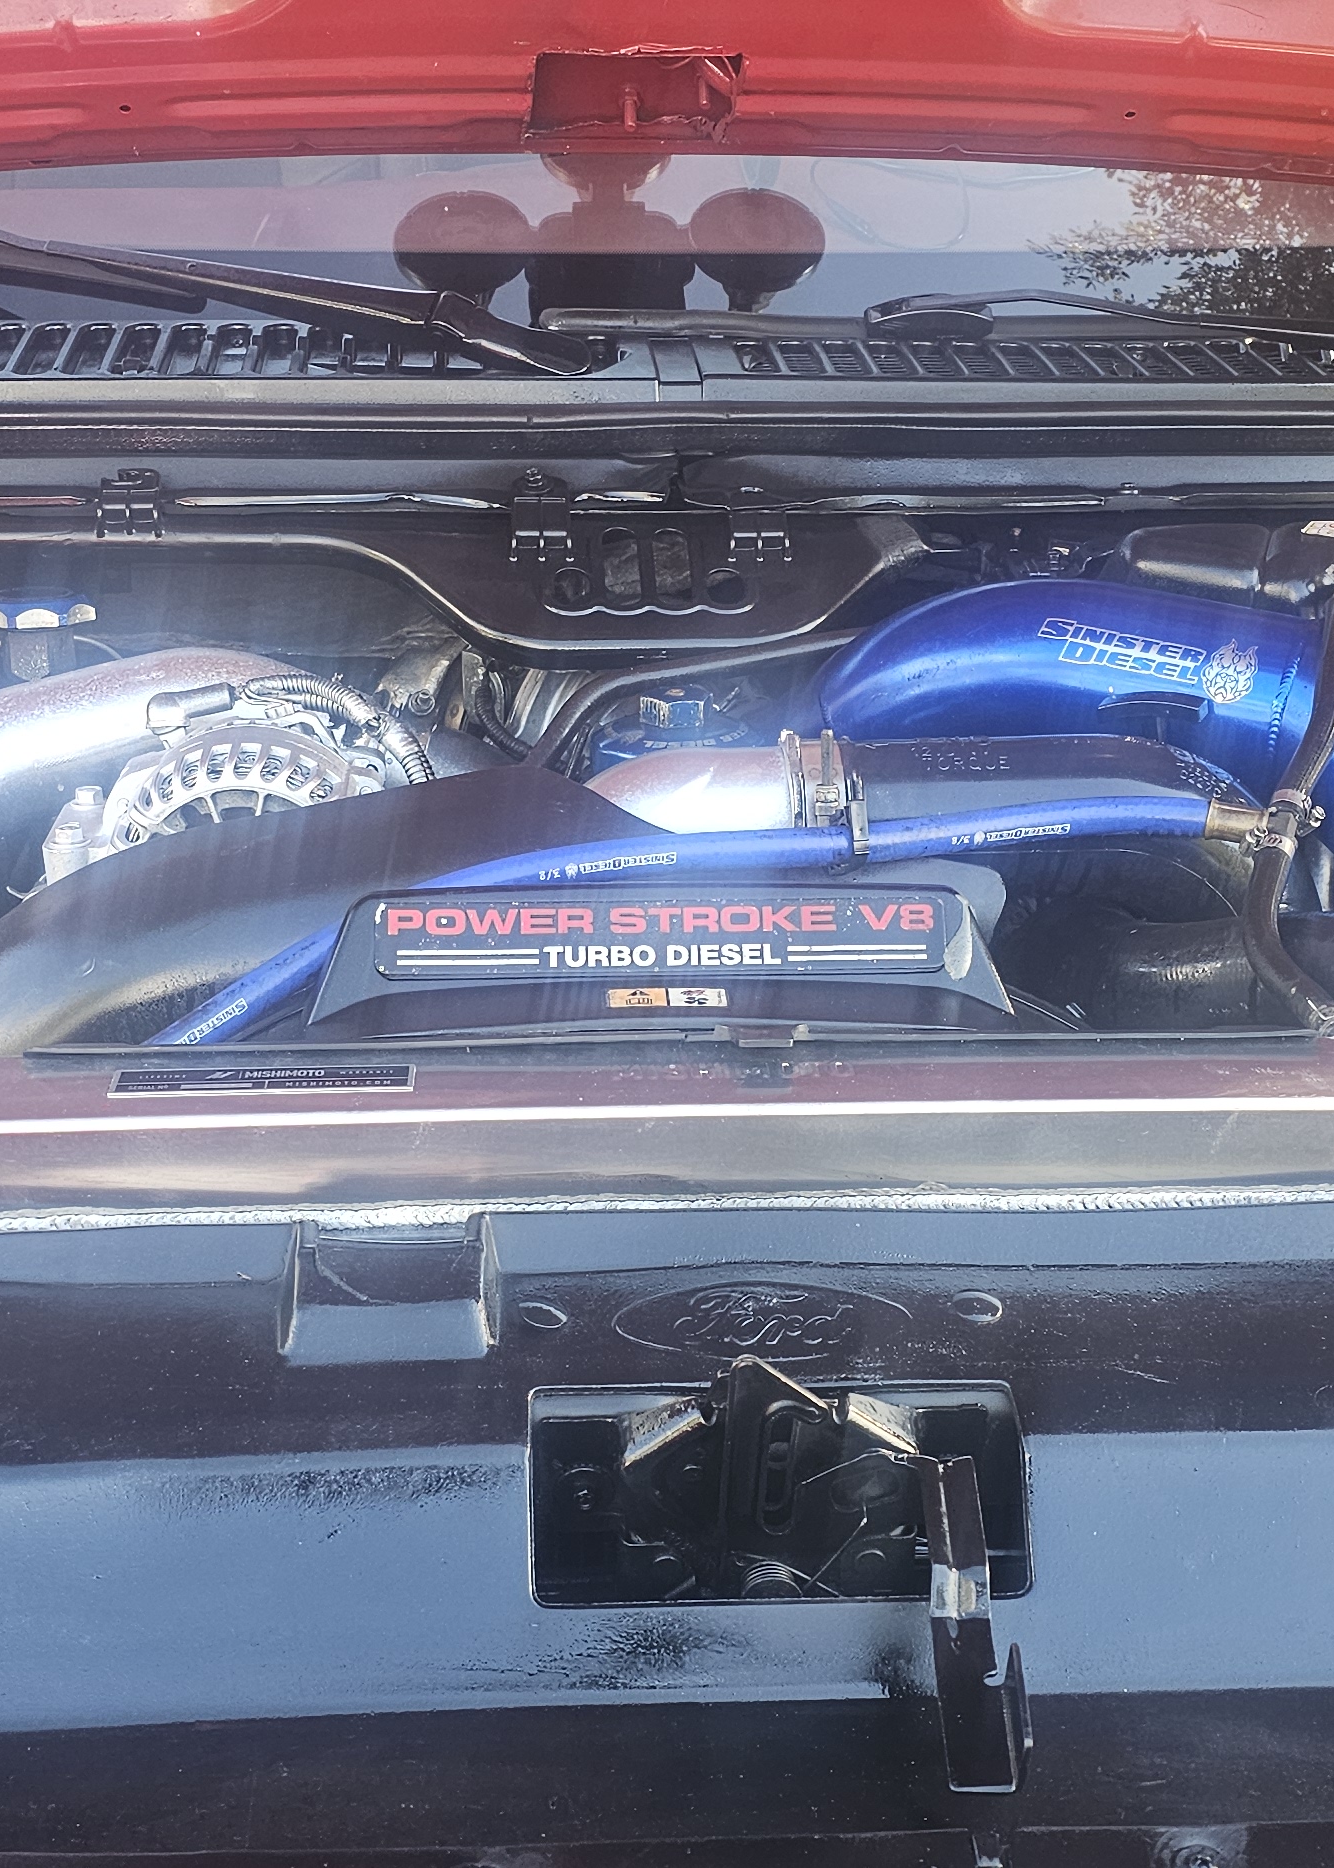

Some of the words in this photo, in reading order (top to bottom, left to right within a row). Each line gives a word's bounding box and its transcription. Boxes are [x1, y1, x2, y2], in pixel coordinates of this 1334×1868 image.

[1037, 618, 1207, 666] SINISTER
[1058, 639, 1199, 684] DIESEL
[922, 756, 1010, 770] TORQUE
[386, 907, 594, 936] POWER
[610, 905, 837, 933] STROKE
[858, 904, 934, 931] V8
[542, 945, 656, 968] TURBO
[666, 943, 782, 967] DIESEL
[244, 1069, 325, 1079] MISHIMOTO
